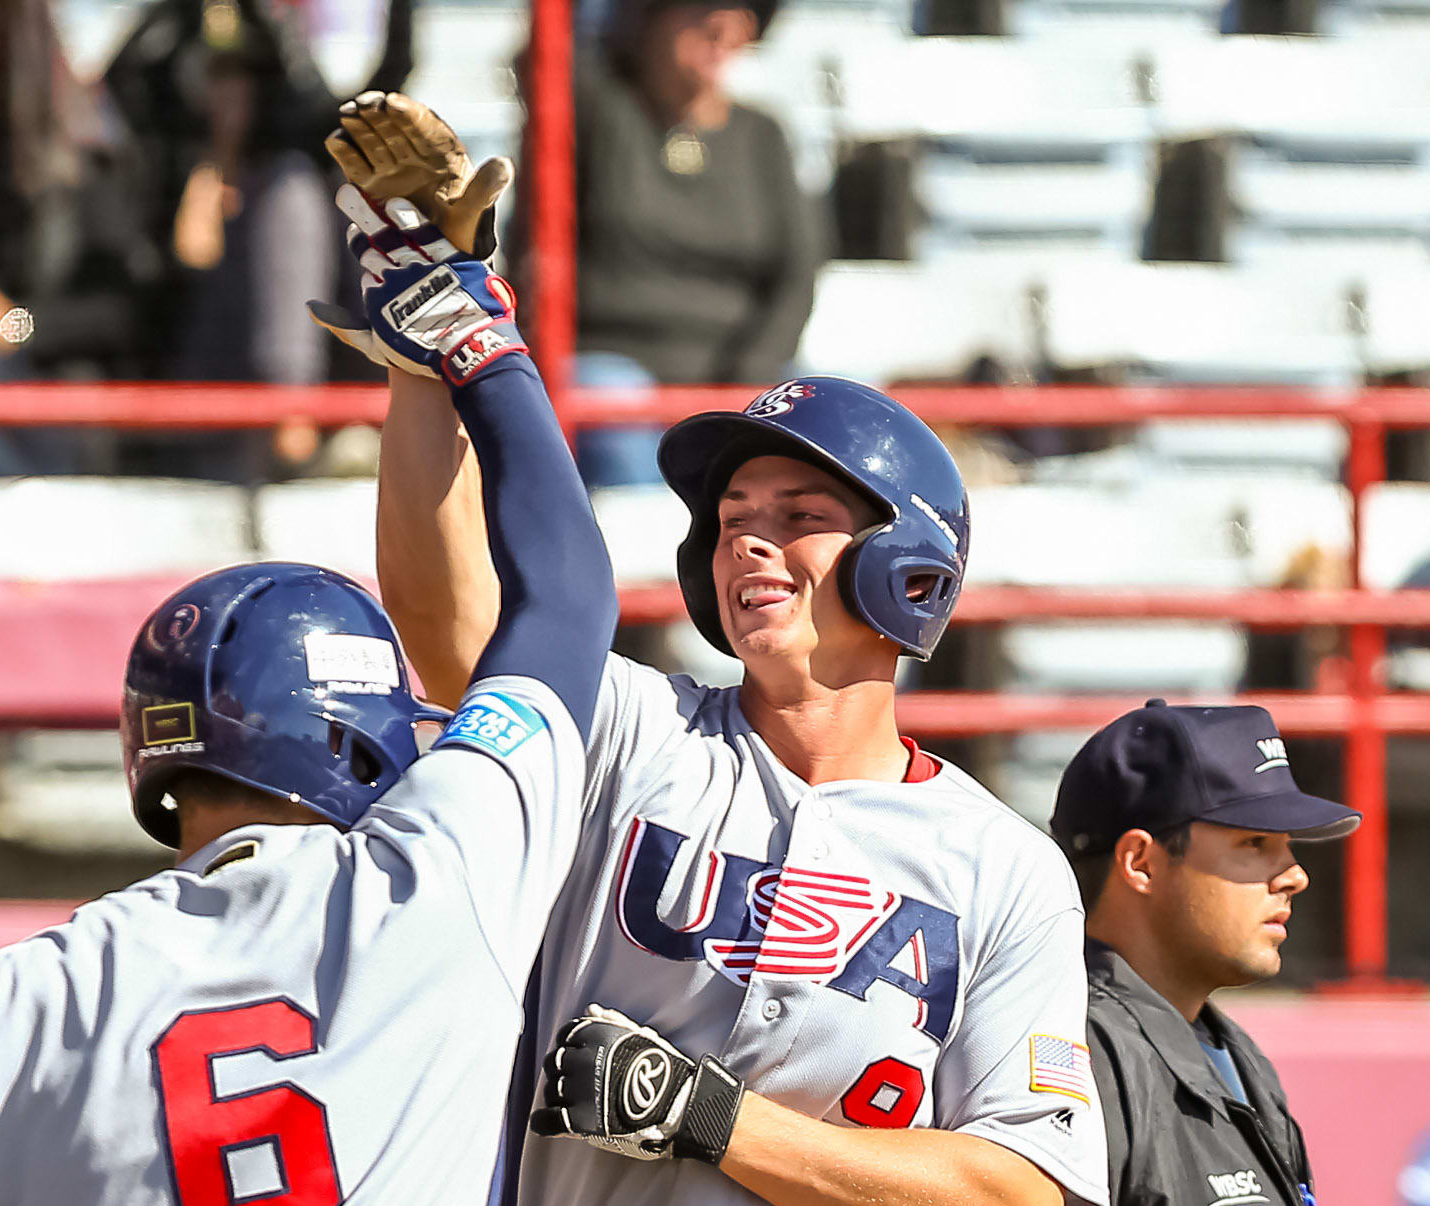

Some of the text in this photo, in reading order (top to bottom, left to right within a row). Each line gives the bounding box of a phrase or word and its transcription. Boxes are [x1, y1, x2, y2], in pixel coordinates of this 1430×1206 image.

[389, 272, 454, 329] Franklin
[615, 815, 961, 1046] USA
[1207, 1168, 1263, 1198] WBSC
